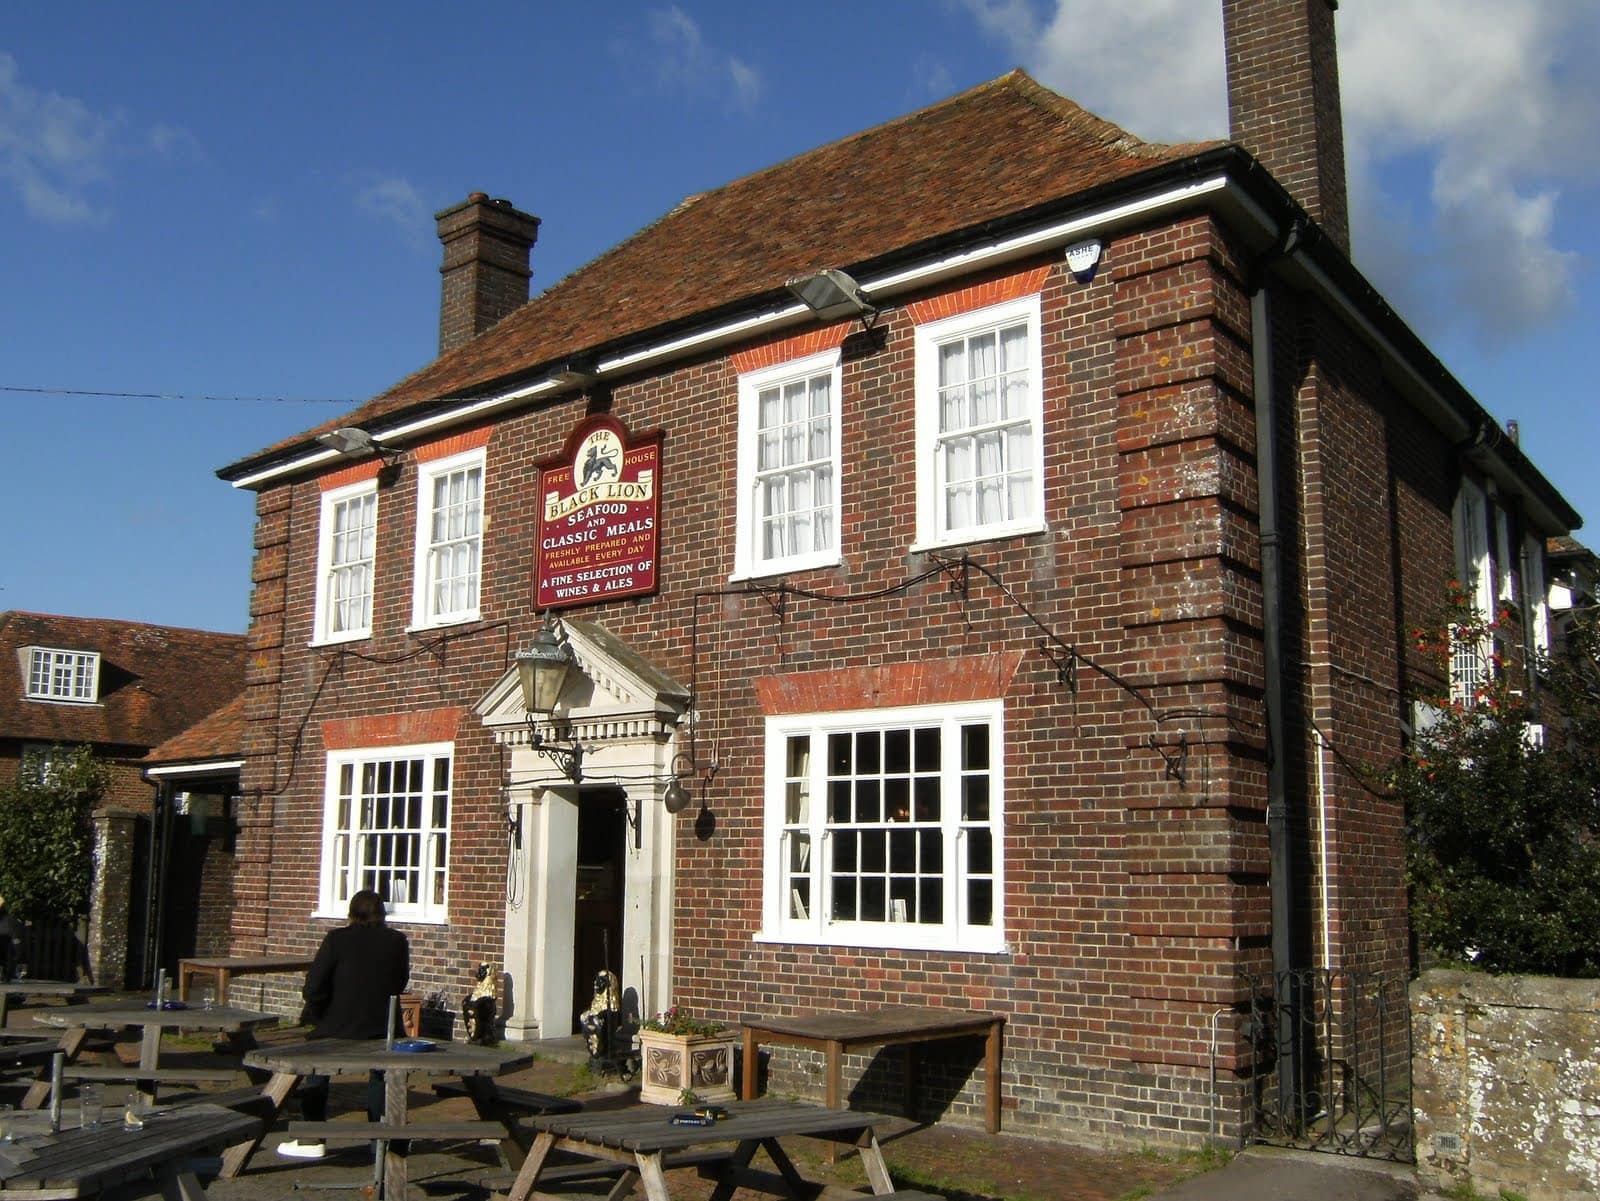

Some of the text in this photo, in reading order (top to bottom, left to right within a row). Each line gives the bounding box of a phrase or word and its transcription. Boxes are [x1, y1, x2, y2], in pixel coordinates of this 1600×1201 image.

[589, 431, 610, 446] THE
[547, 452, 656, 485] FREE HOUSE
[550, 484, 649, 519] BLACK LION
[567, 503, 628, 527] SEAFOOD
[586, 518, 606, 528] AND
[543, 517, 654, 550] CLASSIC MEALS
[545, 533, 651, 561] FRESHLY PREPARED AND
[549, 545, 646, 569] AVAILABLE EVERY DAY
[541, 560, 653, 589] A FINE SELECTION OF
[556, 577, 633, 599] WINES & ALES
